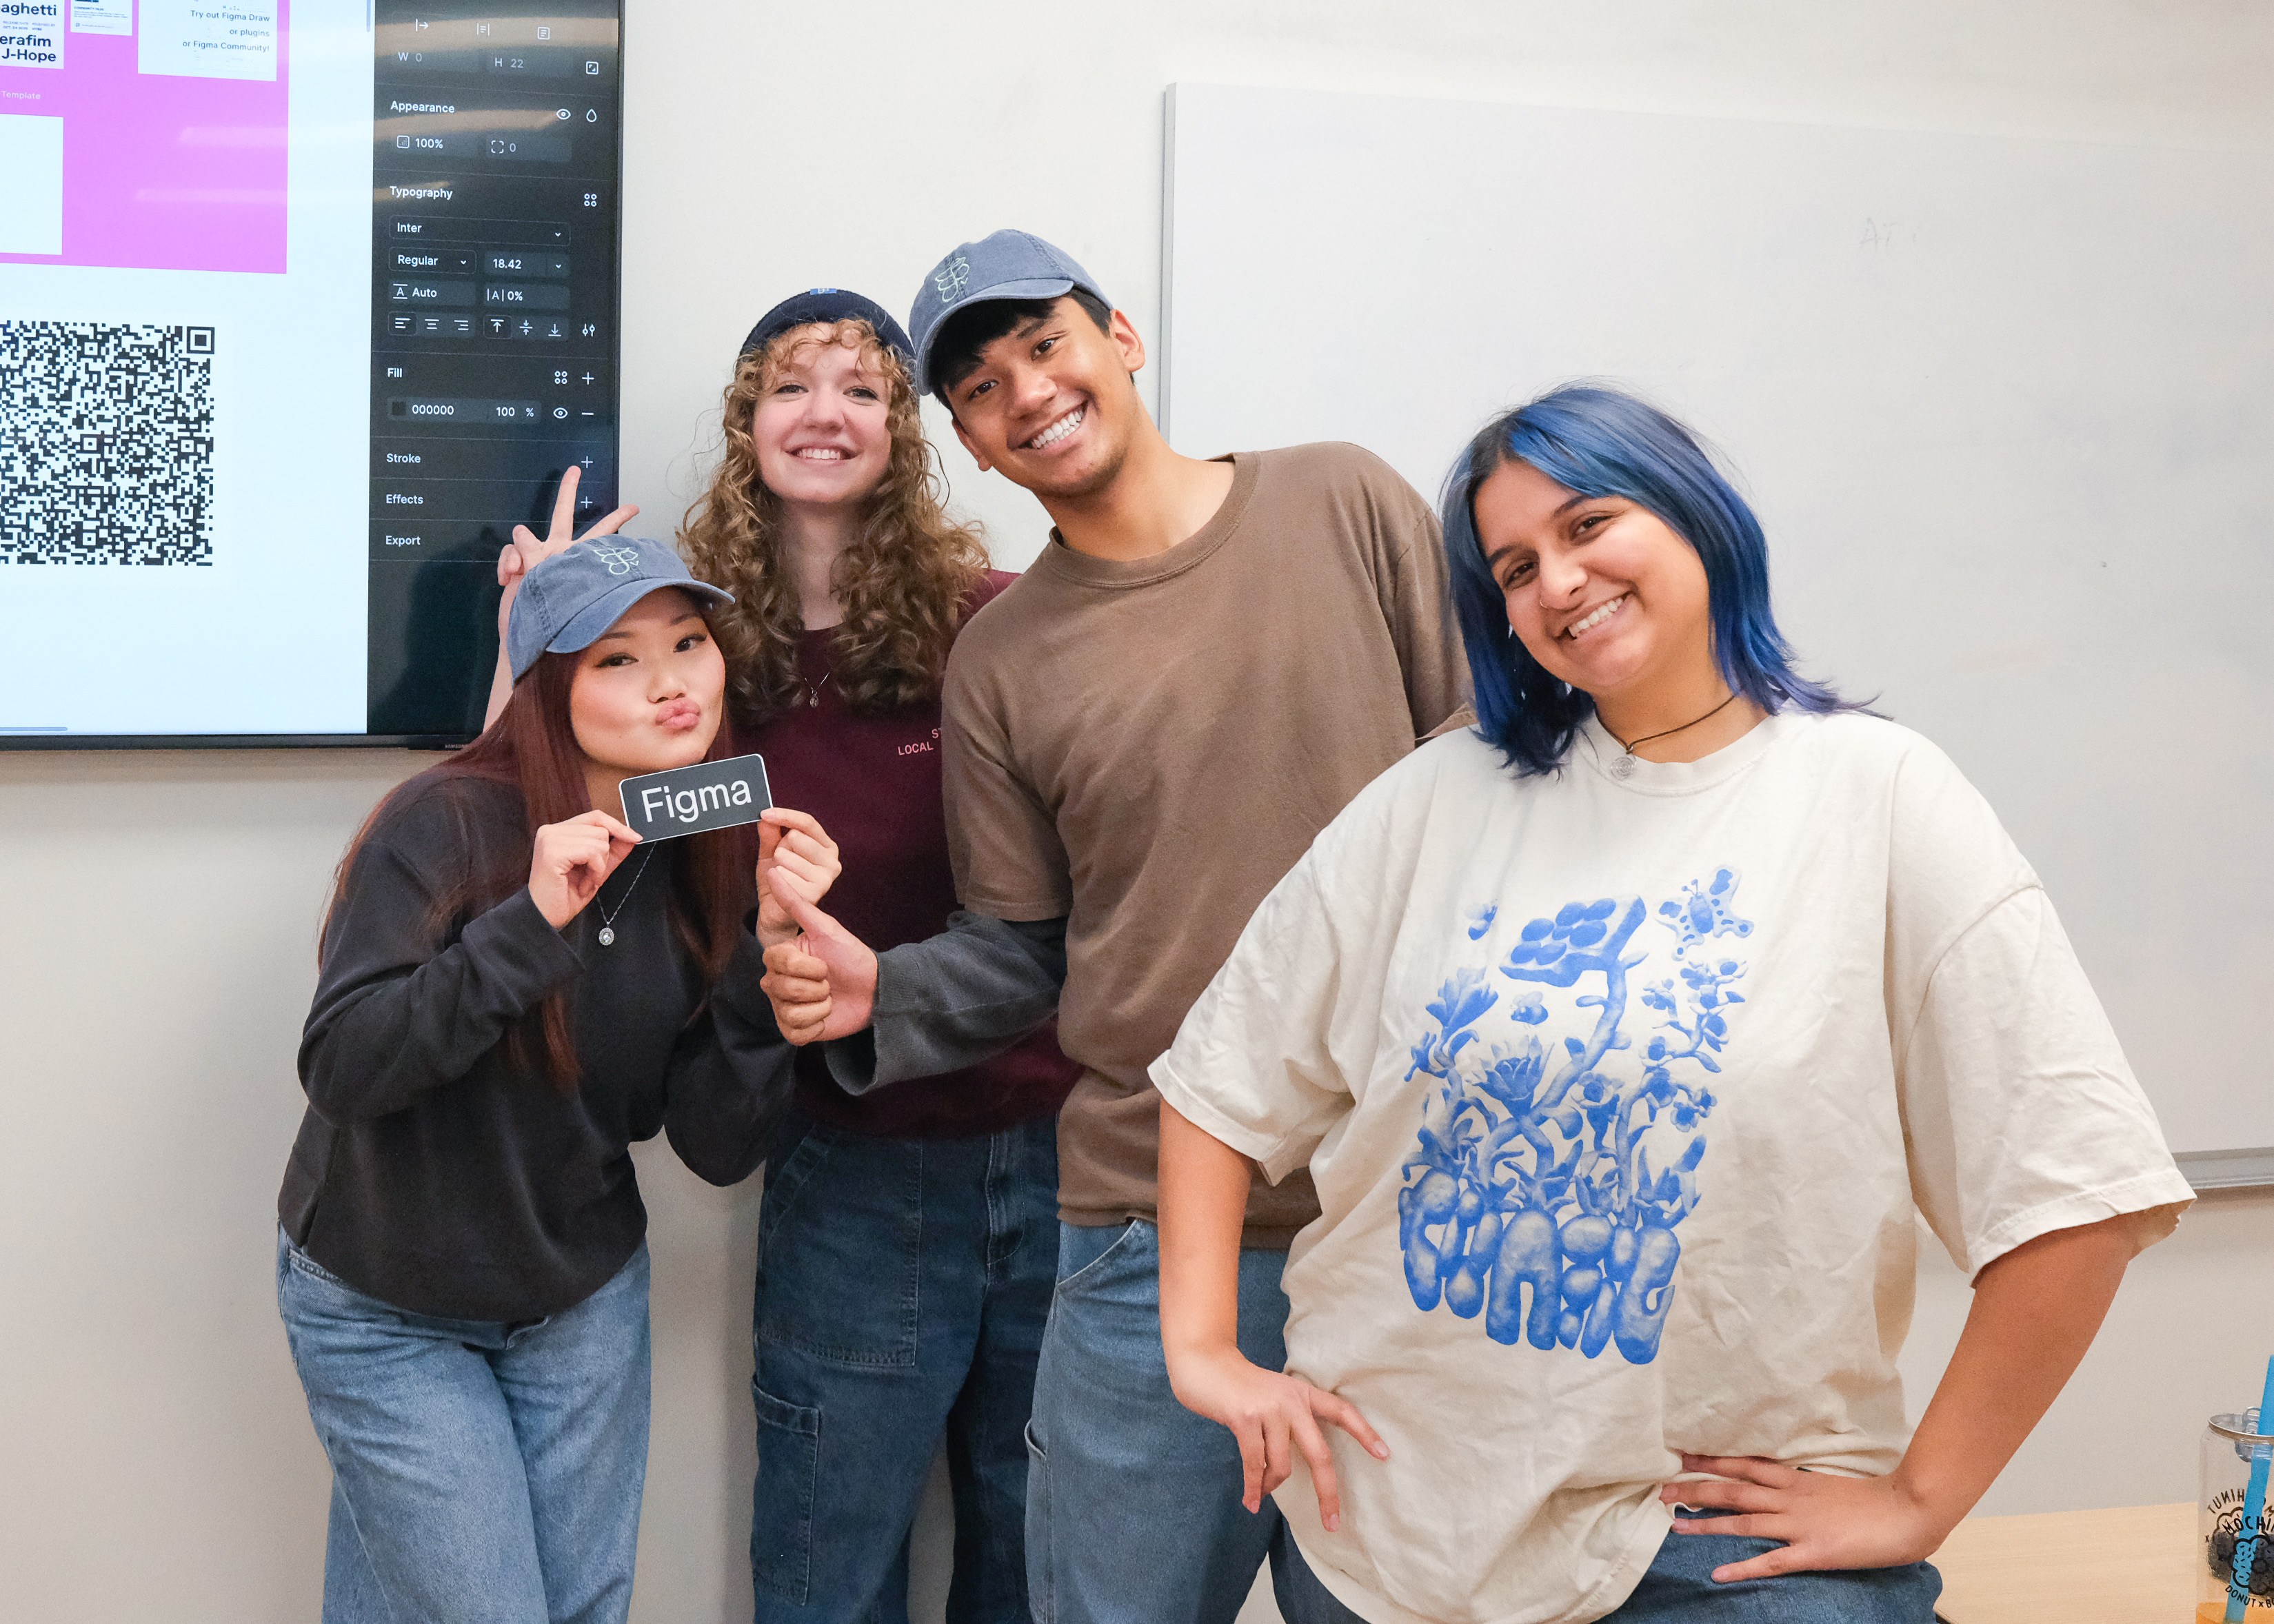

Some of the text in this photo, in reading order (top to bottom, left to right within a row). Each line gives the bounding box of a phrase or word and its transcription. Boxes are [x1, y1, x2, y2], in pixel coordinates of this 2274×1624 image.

[191, 10, 203, 19] Try
[222, 12, 246, 21] Figma
[240, 29, 270, 37] plugins
[0, 34, 51, 47] erafim
[193, 41, 218, 50] Figma
[221, 42, 270, 53] Community!
[1, 48, 57, 63] J-Hope
[398, 52, 423, 62] W 0
[494, 58, 524, 68] H 22
[1, 90, 41, 100] Template
[390, 101, 455, 114] Appearance
[415, 138, 443, 149] 100%
[509, 143, 516, 152] 0
[390, 185, 453, 200] Typography
[397, 223, 422, 233] Inter
[398, 255, 439, 267] Regular
[493, 258, 522, 270] 18.42
[412, 287, 437, 298] Auto
[507, 291, 523, 301] 0%
[388, 367, 403, 378] Fill
[412, 405, 454, 415] 000000
[496, 407, 515, 416] 100
[386, 453, 421, 463] Stroke
[385, 494, 424, 505] Effects
[385, 536, 421, 547] Export
[898, 741, 934, 755] LOCAL
[641, 780, 752, 823] Figma
[2225, 1585, 2256, 1607] DONUT
